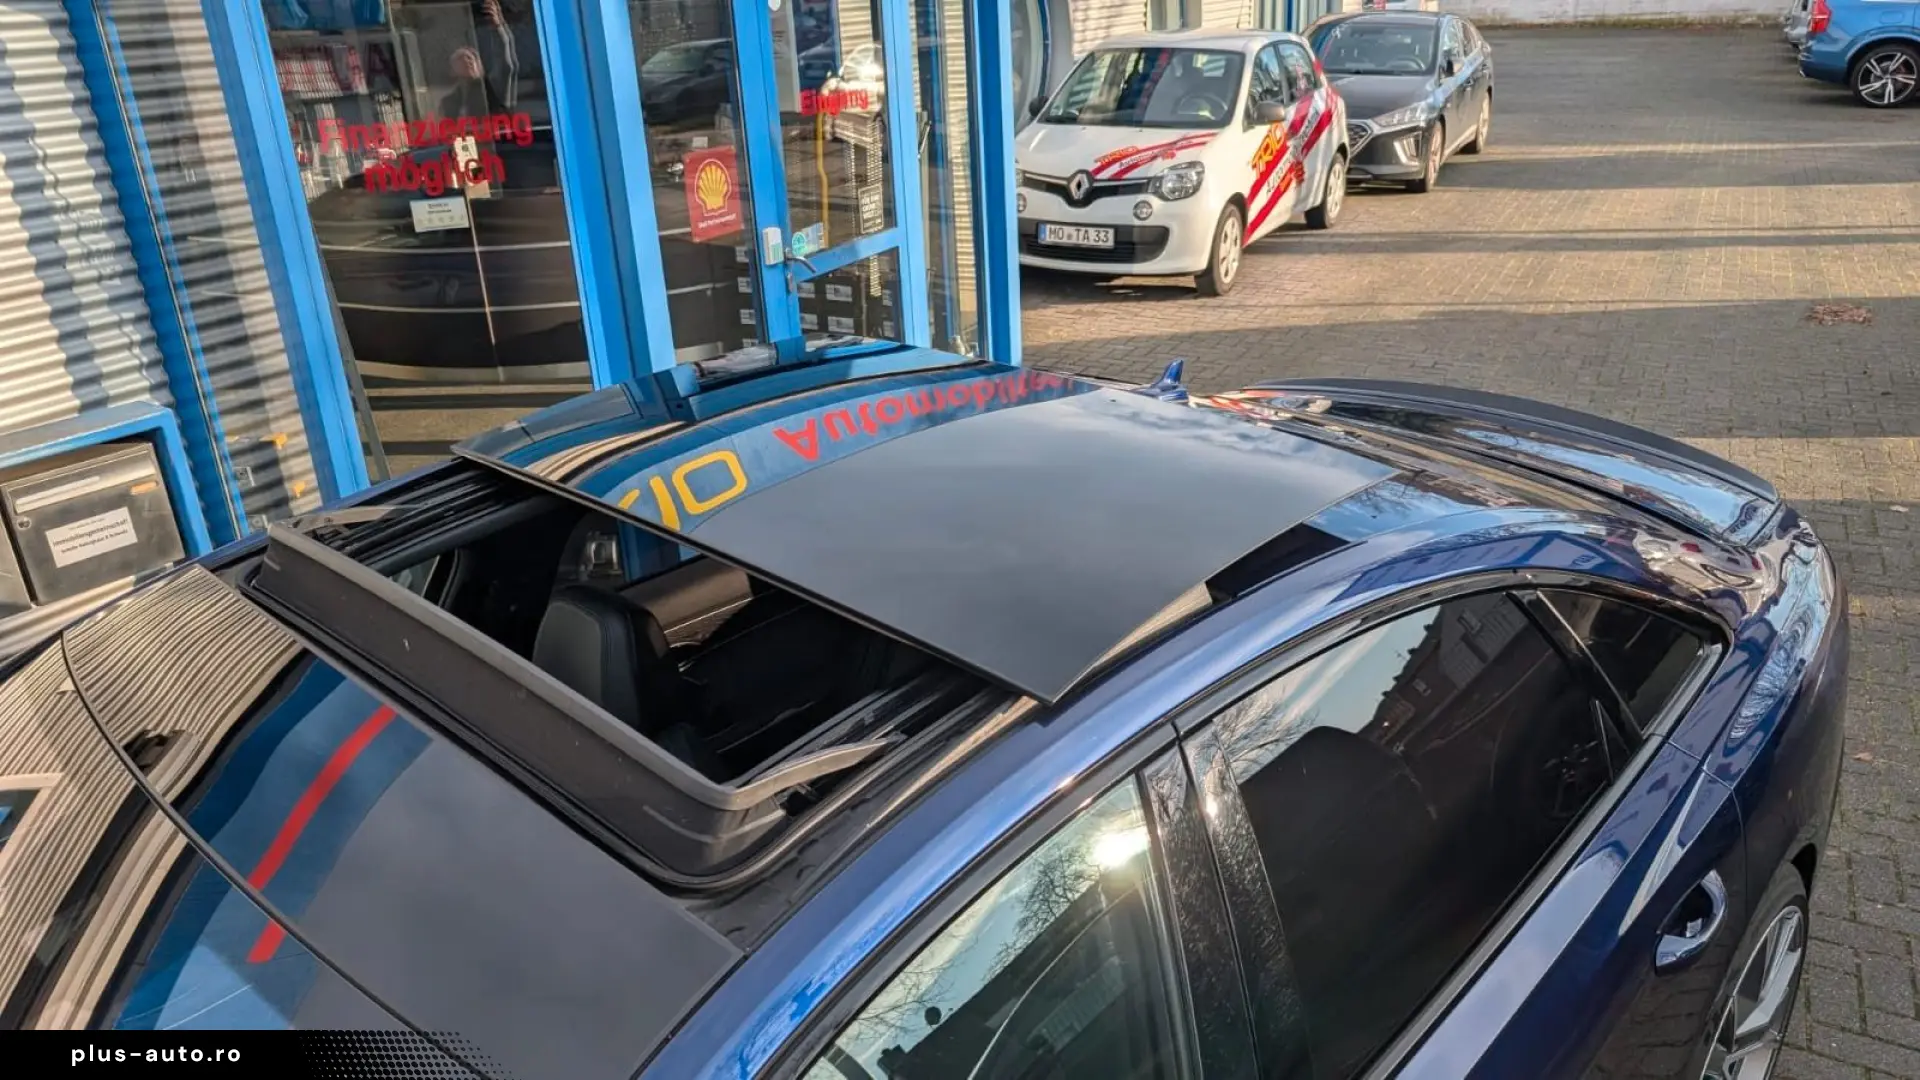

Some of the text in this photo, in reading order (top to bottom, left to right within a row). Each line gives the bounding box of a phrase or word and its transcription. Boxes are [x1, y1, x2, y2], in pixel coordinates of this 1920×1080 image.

[317, 112, 533, 152] Finanzierung
[1249, 122, 1287, 178] TRIO
[364, 150, 506, 196] möglich
[1094, 230, 1109, 244] 33
